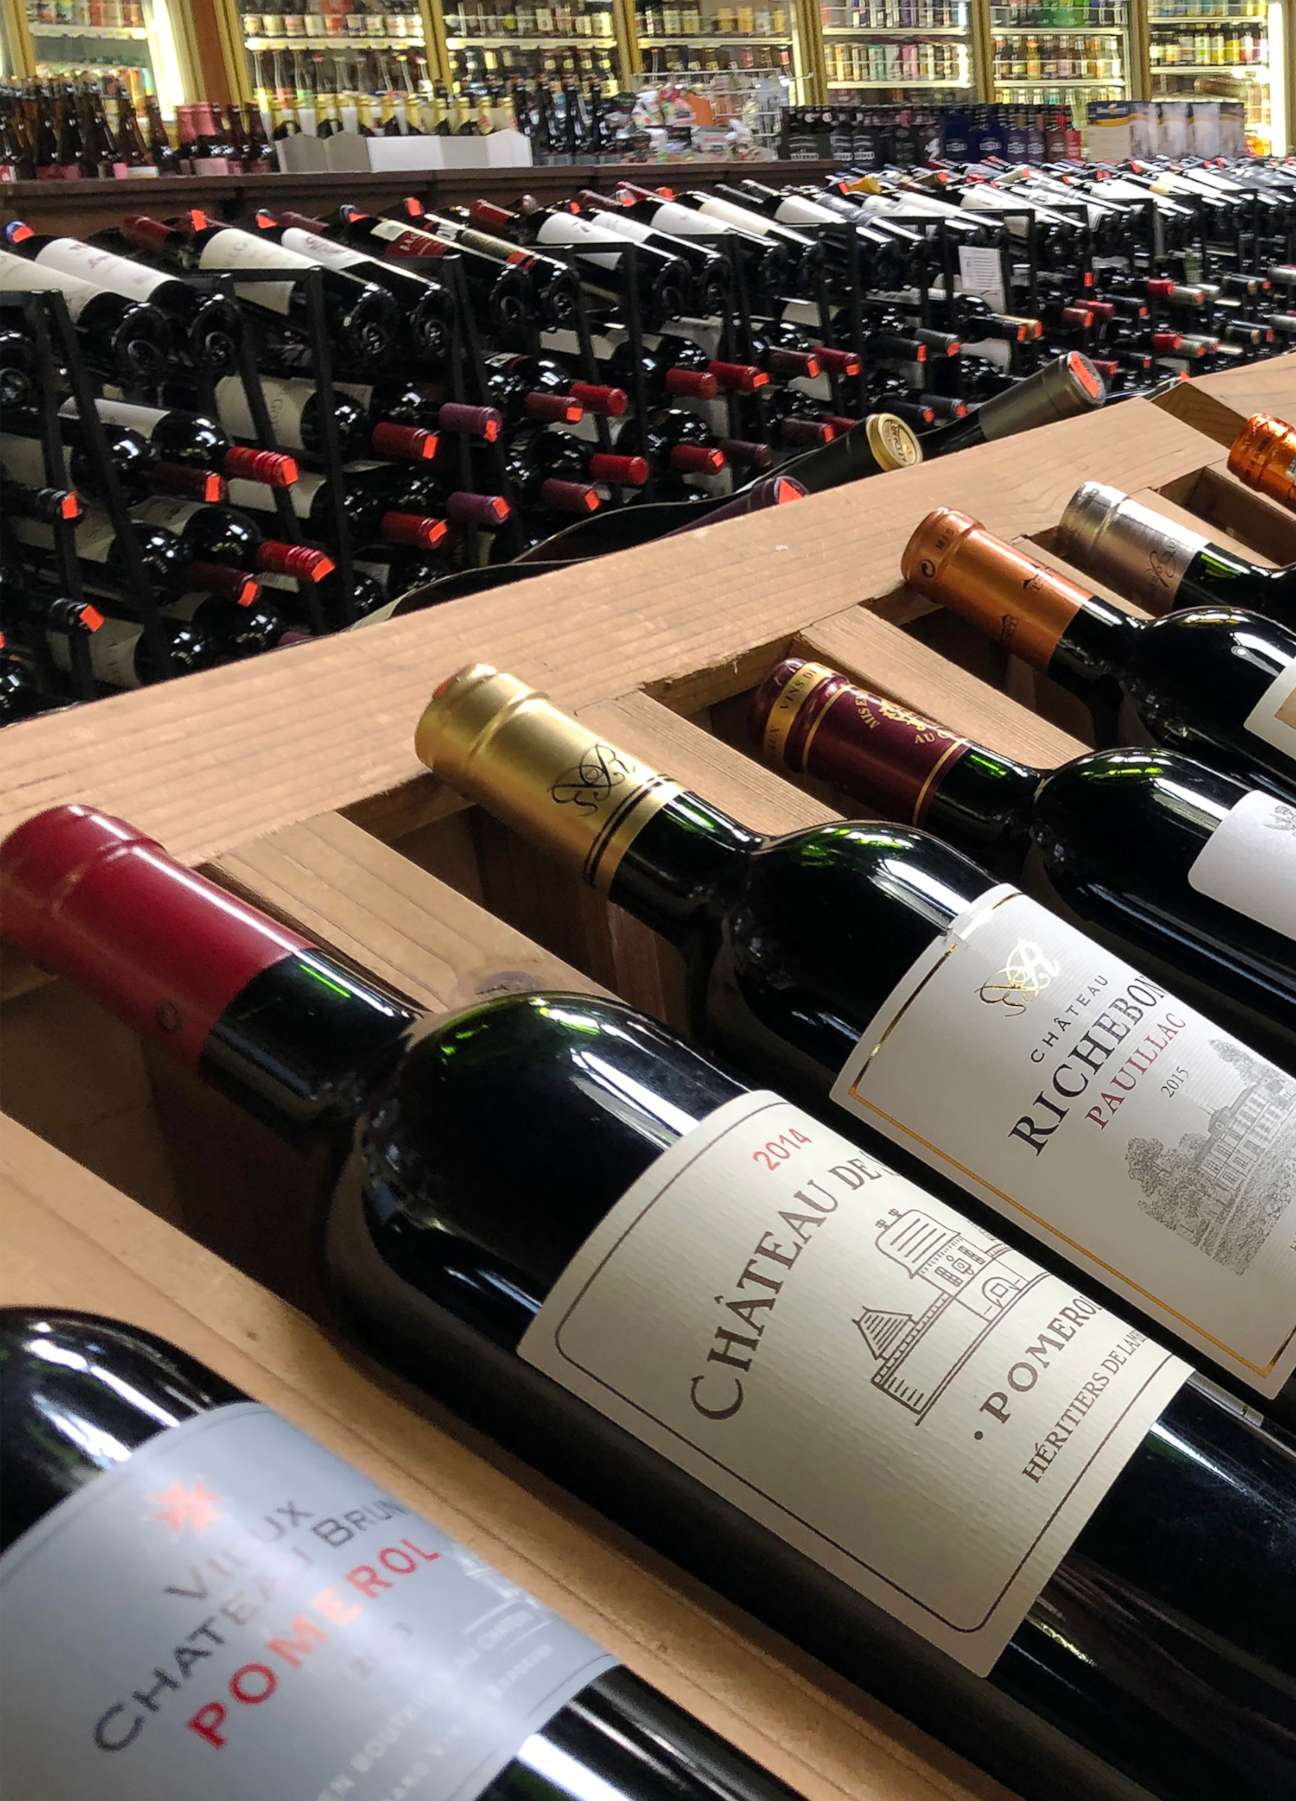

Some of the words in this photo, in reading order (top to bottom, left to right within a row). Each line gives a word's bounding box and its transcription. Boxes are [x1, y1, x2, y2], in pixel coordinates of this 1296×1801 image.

[1008, 974, 1167, 1157] RICHEBON
[1031, 974, 1110, 1065] CHÂTEAU
[1084, 1011, 1187, 1131] PAUILLAC
[1160, 1064, 1190, 1099] 2015
[752, 1127, 812, 1172] 2014
[690, 1178, 840, 1421] CHÂTEAU
[831, 1156, 882, 1192] DE
[1021, 1367, 1109, 1484] HÉRITIERS
[1102, 1348, 1129, 1374] DE
[186, 1537, 440, 1750] POMEROL
